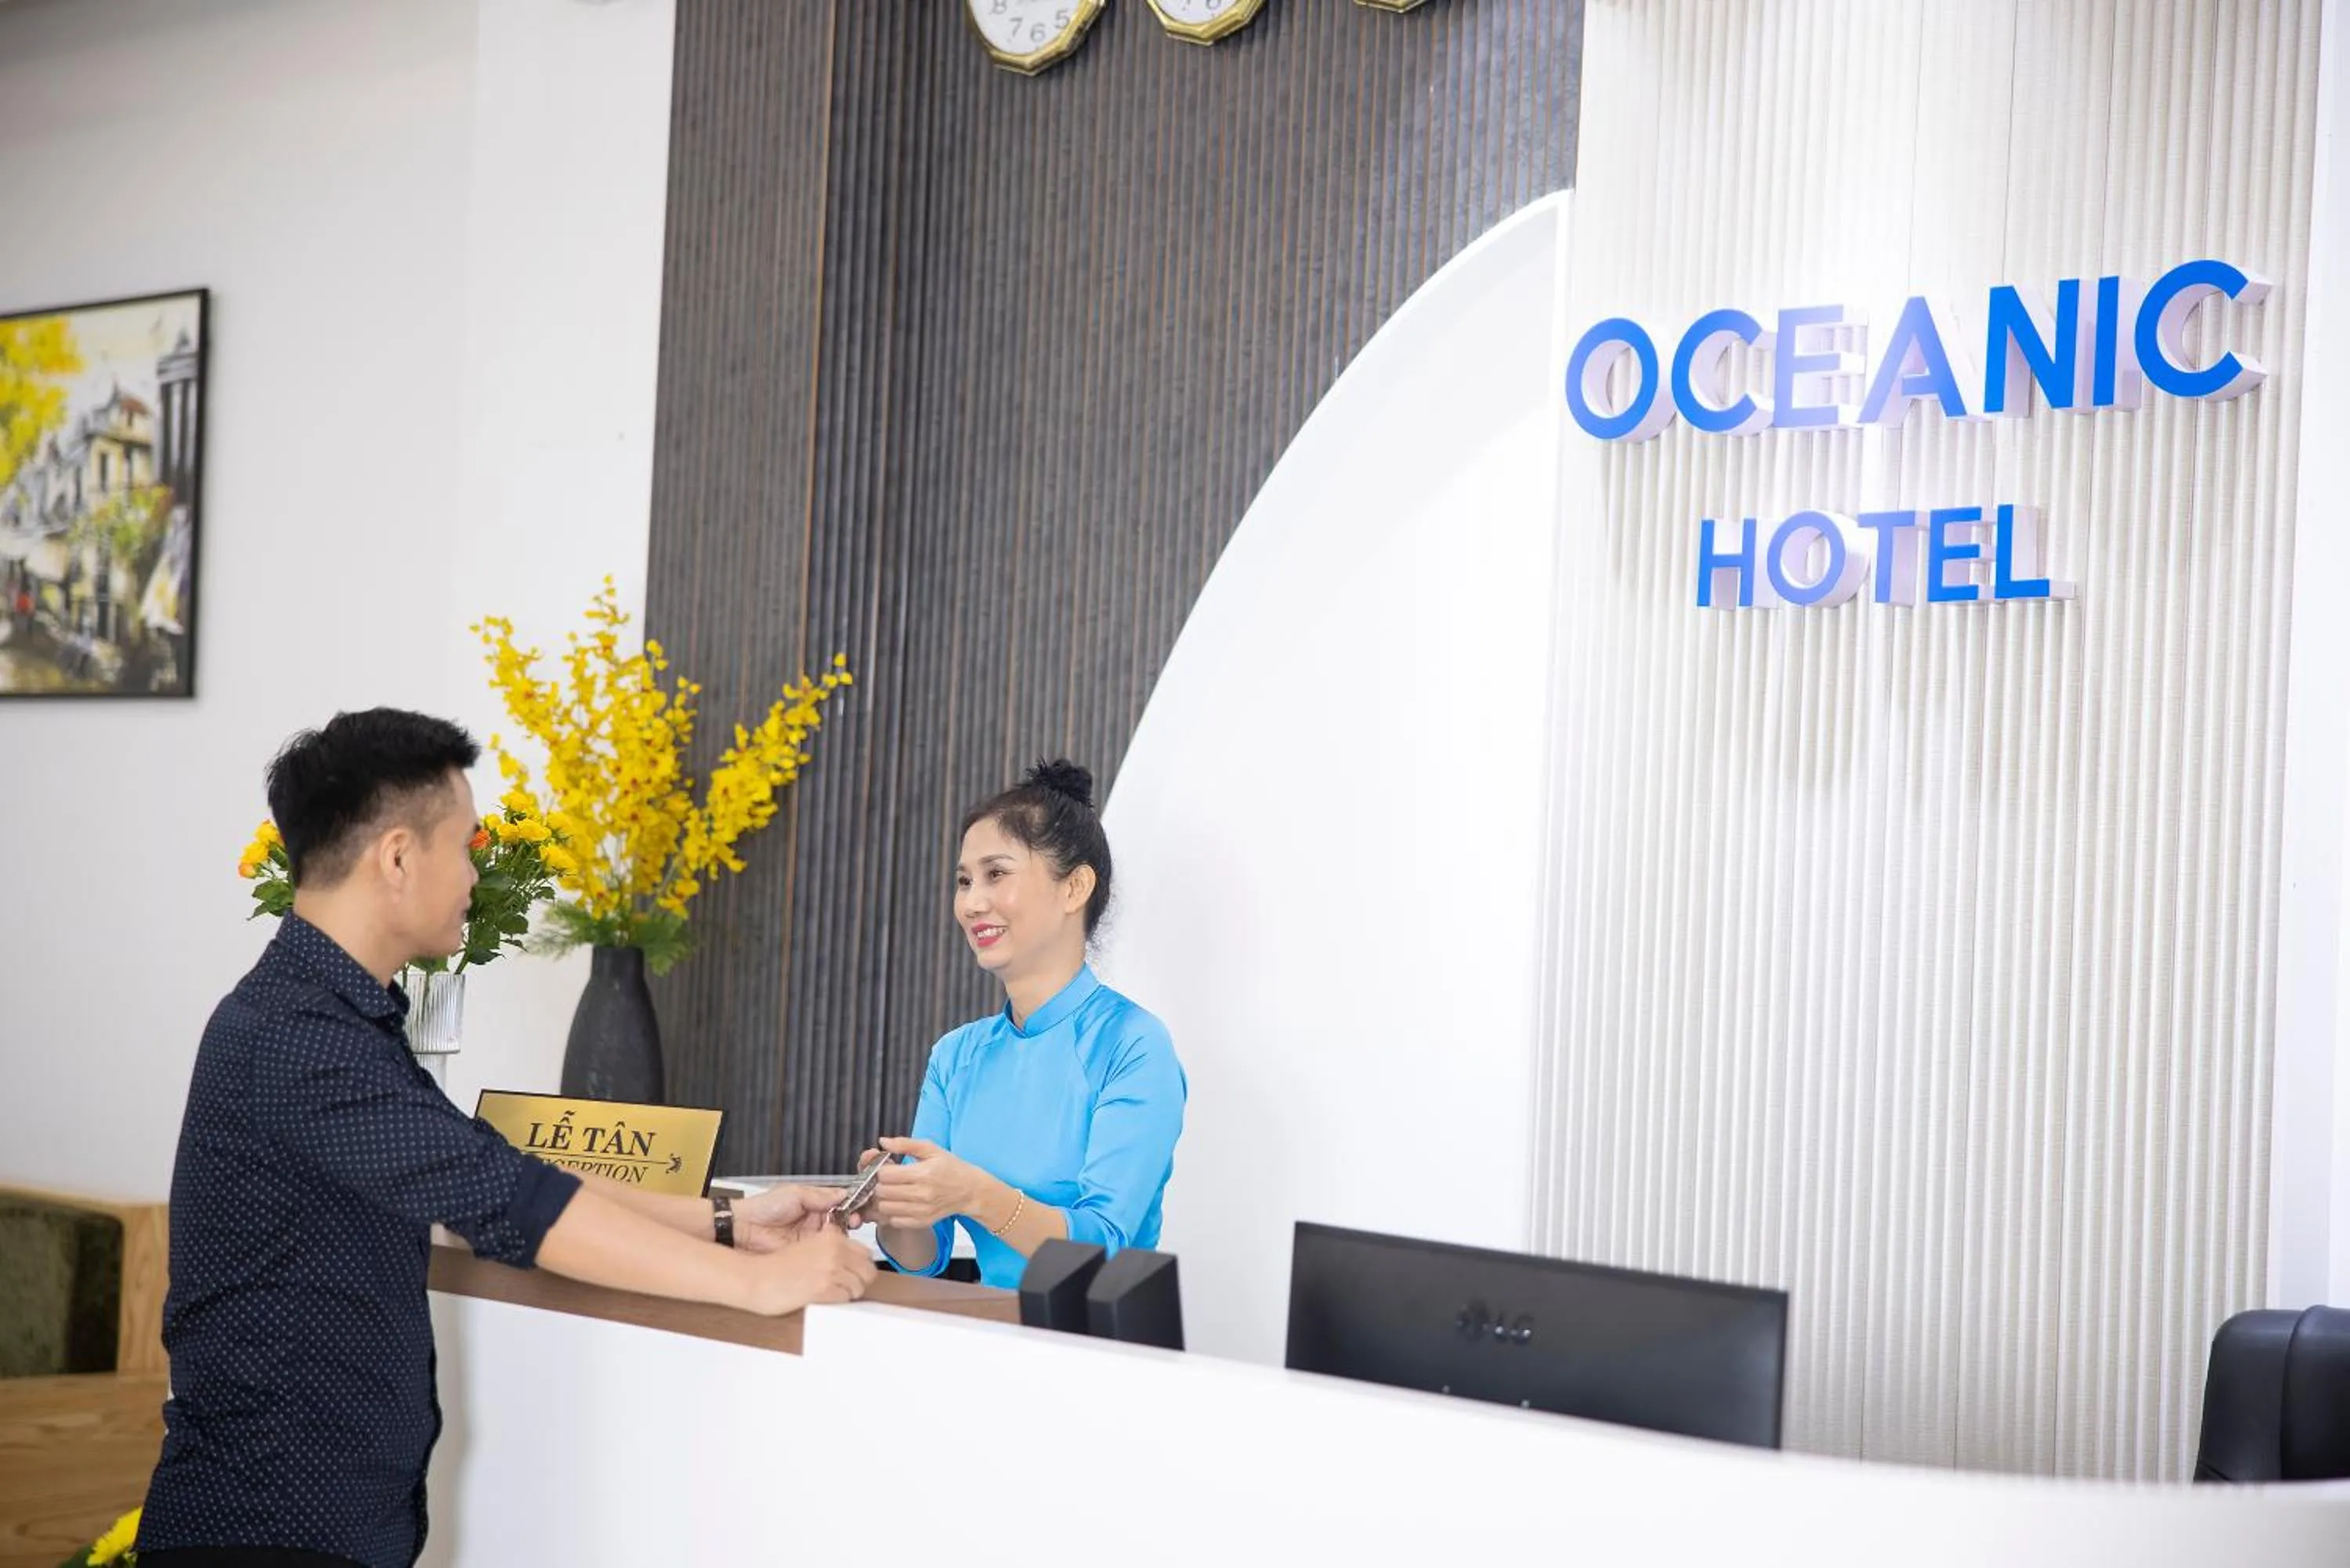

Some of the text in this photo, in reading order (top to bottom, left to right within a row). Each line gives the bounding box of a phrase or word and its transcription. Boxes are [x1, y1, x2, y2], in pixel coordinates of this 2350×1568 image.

[1009, 17, 1023, 37] 7
[1030, 22, 1046, 43] 6
[1055, 9, 1070, 29] 5
[1566, 259, 2251, 439] OCEANIC
[1697, 504, 2051, 607] HOTEL
[526, 1111, 656, 1156] LỄ TÂN
